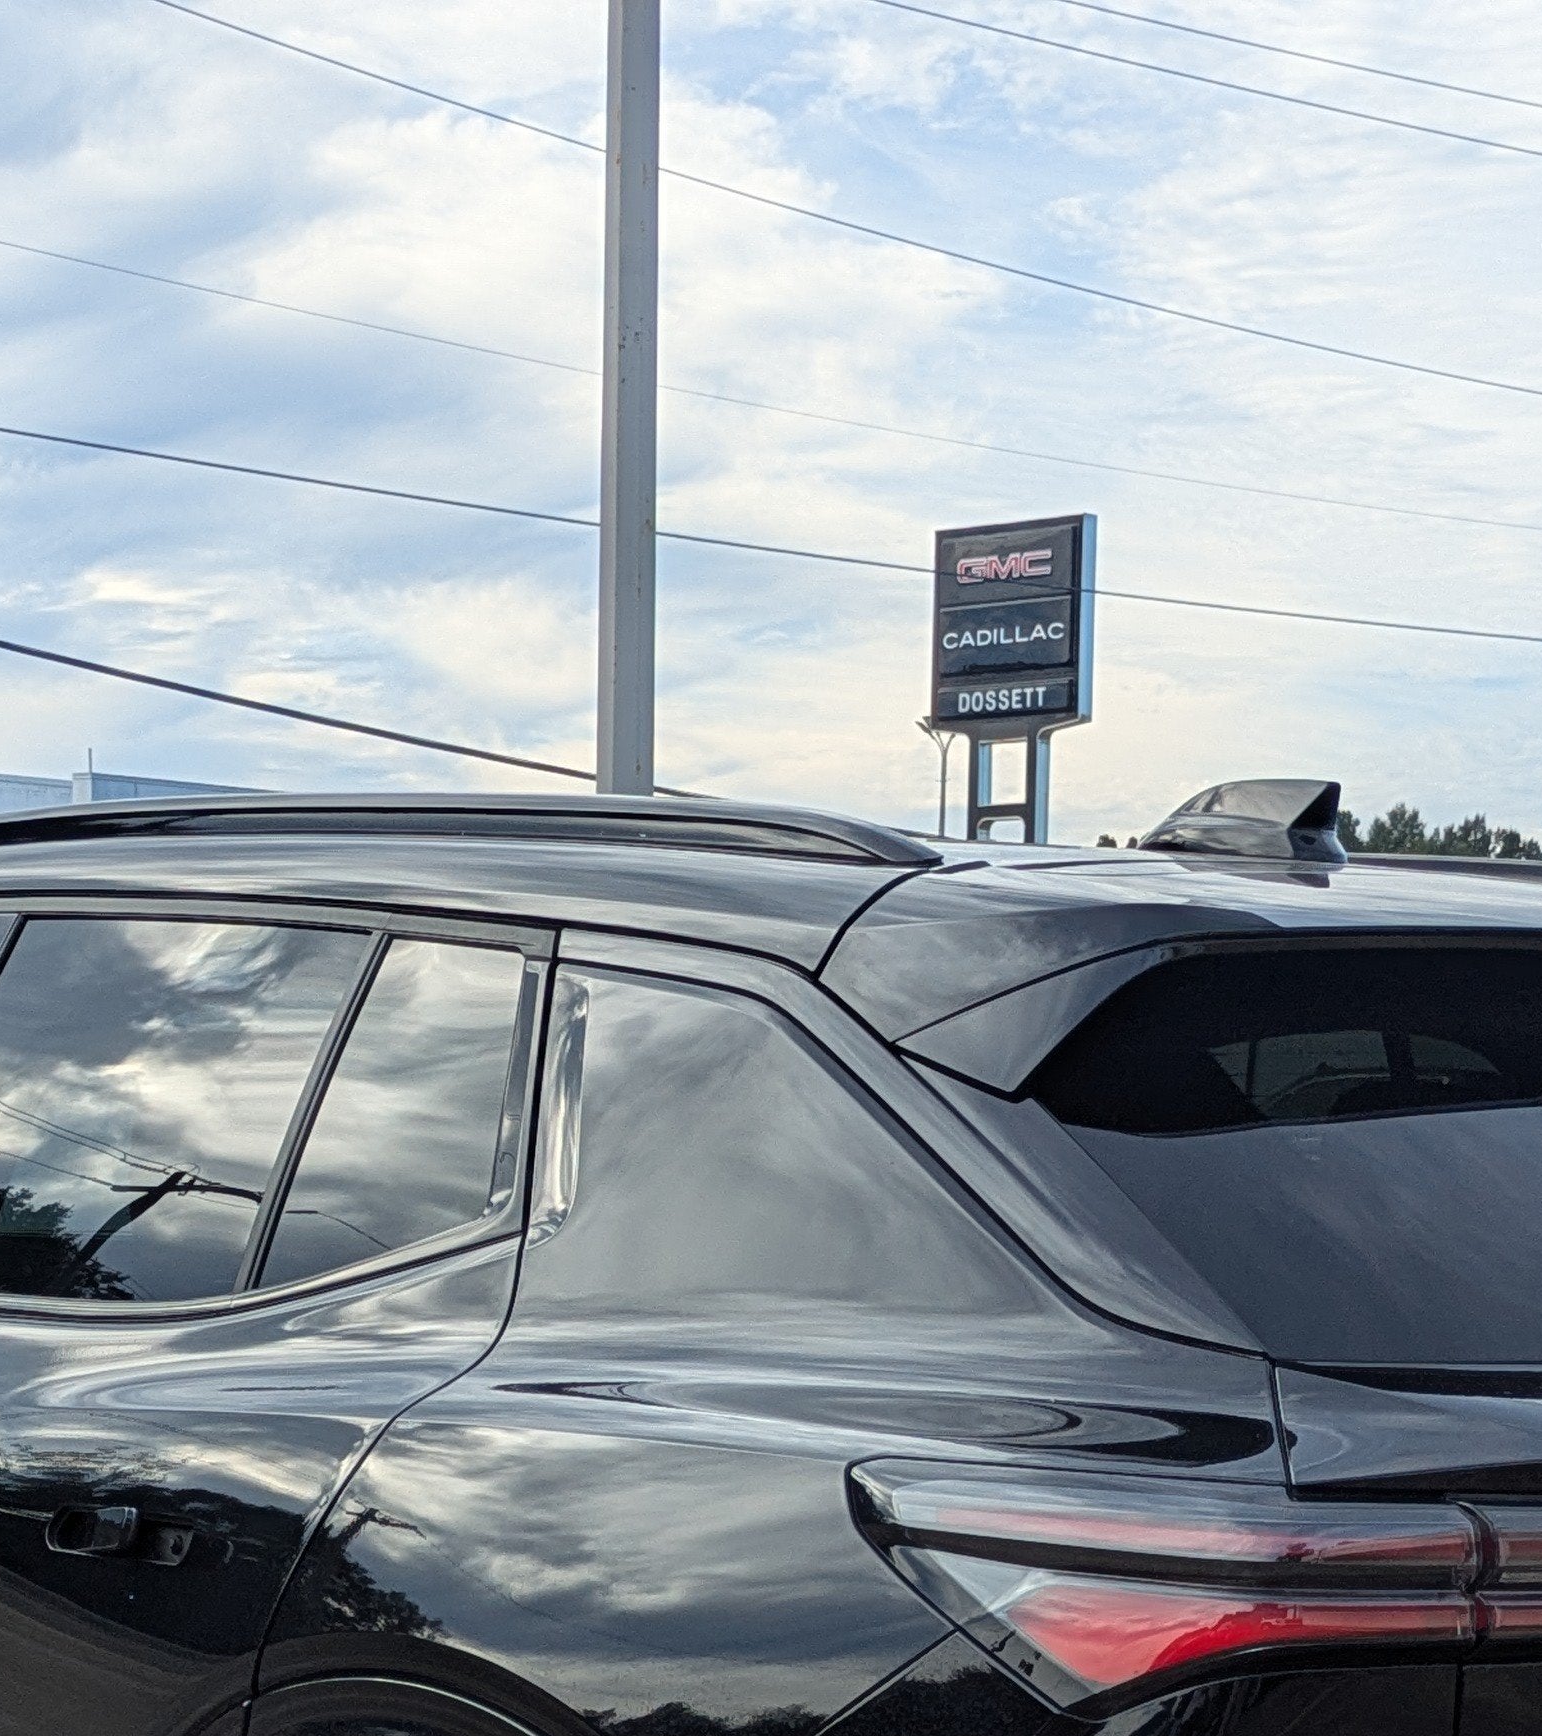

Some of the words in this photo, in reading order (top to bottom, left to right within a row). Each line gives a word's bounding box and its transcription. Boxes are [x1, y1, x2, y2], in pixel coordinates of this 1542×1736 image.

[956, 549, 1052, 584] GMC
[942, 622, 1065, 650] CADILLAC
[957, 686, 1047, 713] DOSSETT
